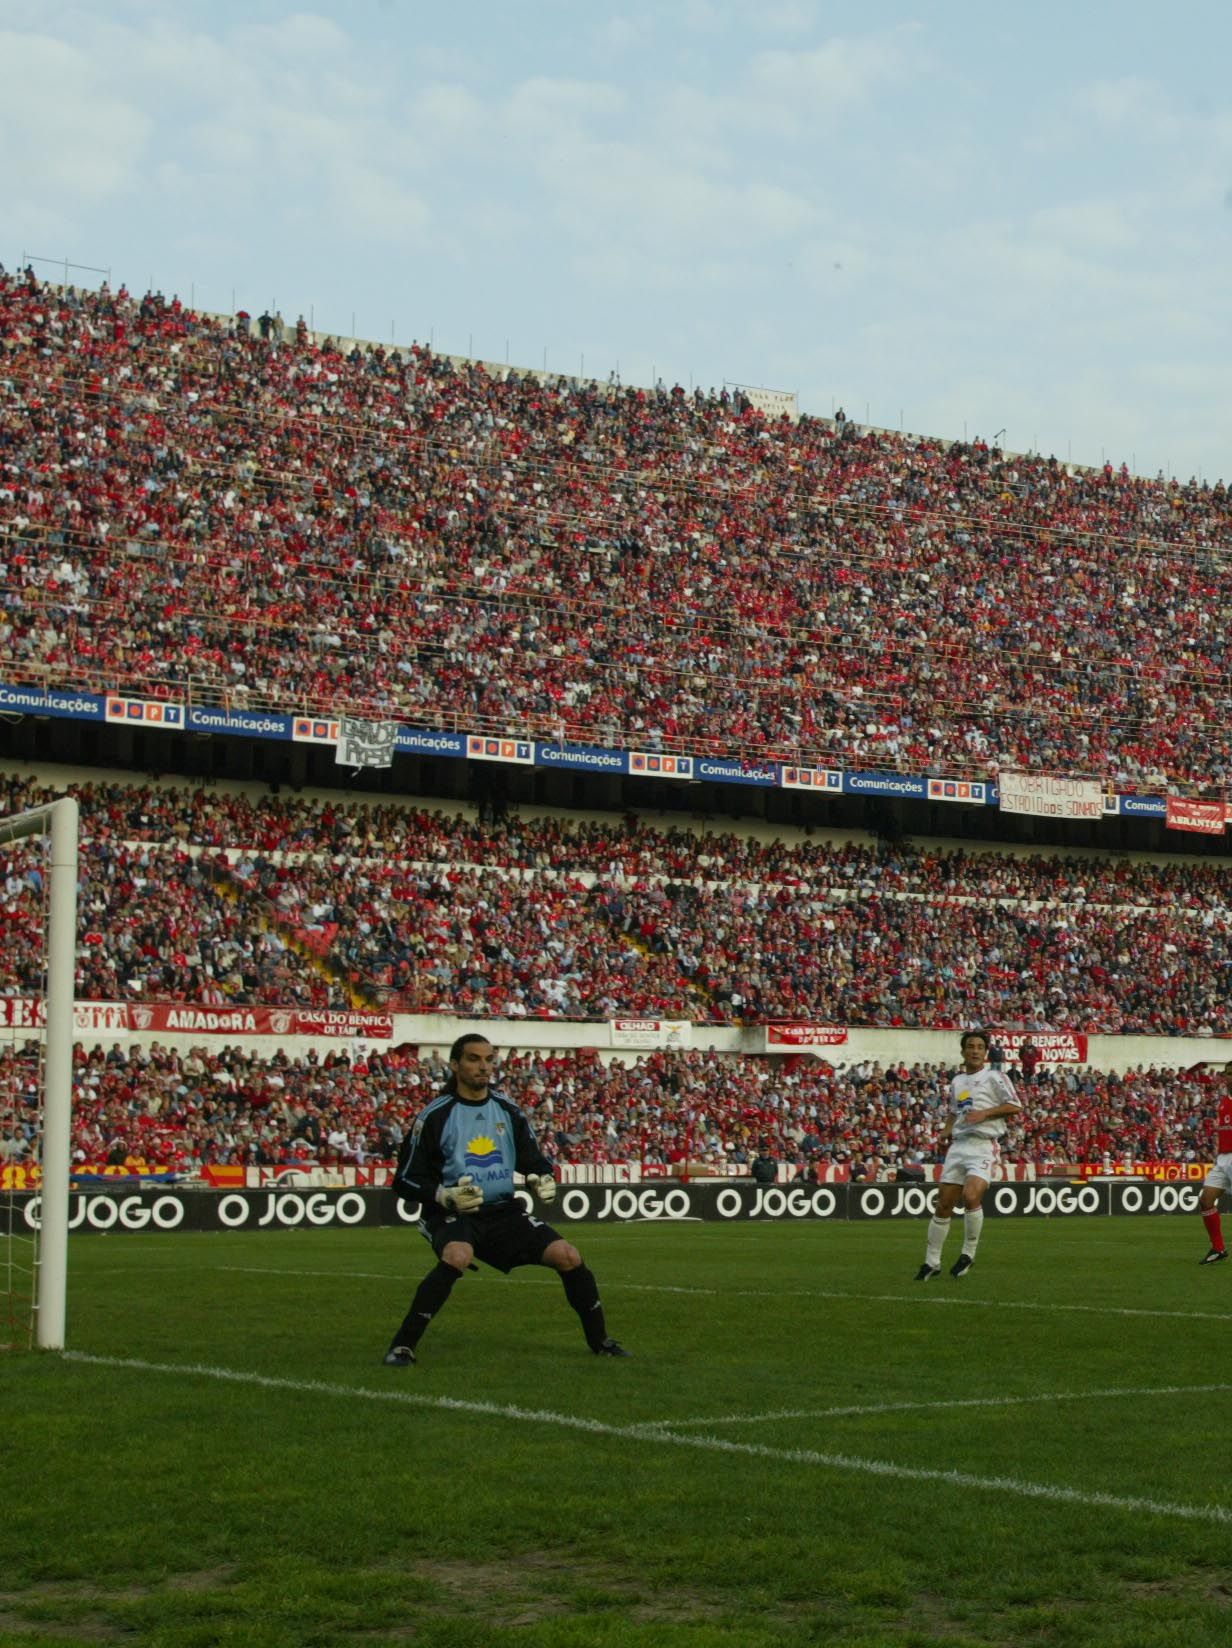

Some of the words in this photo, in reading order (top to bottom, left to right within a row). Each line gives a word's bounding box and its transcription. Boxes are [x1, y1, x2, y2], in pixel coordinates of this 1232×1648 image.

[191, 711, 286, 734] Comunicações
[541, 748, 623, 768] Comunicações
[849, 776, 924, 794] Comunicações
[1124, 799, 1168, 813] Comunic
[1169, 815, 1223, 829] ABRANTES
[298, 1011, 327, 1024] CASA
[328, 1013, 347, 1024] DO
[348, 1014, 393, 1027] BENFICA
[990, 1034, 1010, 1048] ASA
[1031, 1035, 1075, 1048] BENFICA
[1041, 1048, 1080, 1061] NOVAS
[218, 1194, 250, 1227] O
[258, 1193, 366, 1227] JOGO
[562, 1190, 590, 1220] O
[597, 1189, 691, 1220] JOGO
[716, 1189, 742, 1217] O
[749, 1188, 836, 1217] JOGO
[860, 1188, 885, 1216] O
[994, 1187, 1018, 1215] O
[1023, 1186, 1100, 1214] JOGO
[1121, 1186, 1143, 1212] O
[1148, 1185, 1201, 1213] JOG
[69, 1195, 185, 1229] JOGO
